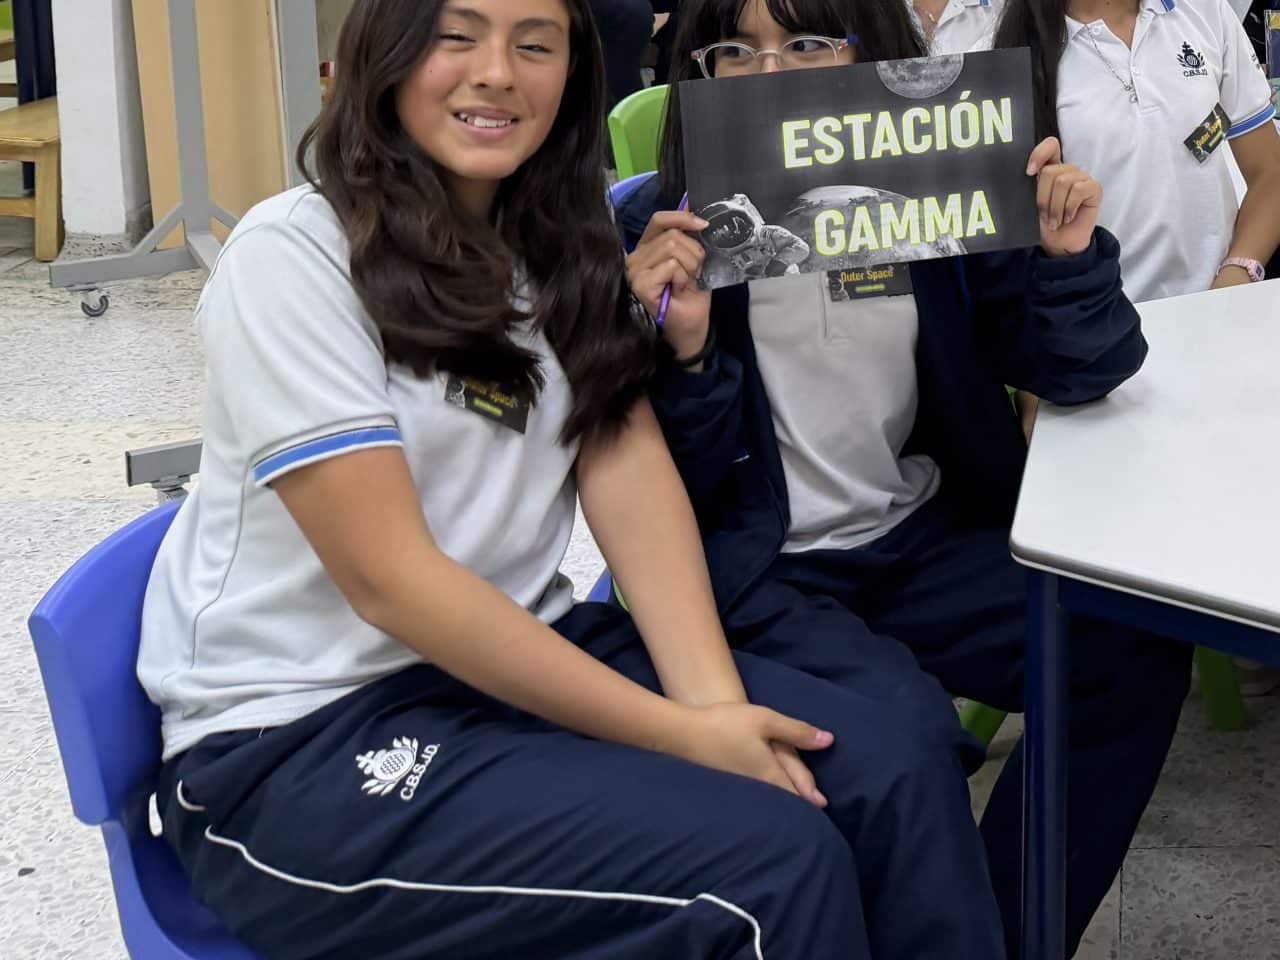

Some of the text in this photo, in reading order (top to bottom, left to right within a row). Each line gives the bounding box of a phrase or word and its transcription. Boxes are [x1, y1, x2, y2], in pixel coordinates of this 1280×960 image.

[782, 90, 1014, 169] ESTACIÓN
[814, 190, 997, 257] GAMMA
[840, 269, 894, 283] Outer Space
